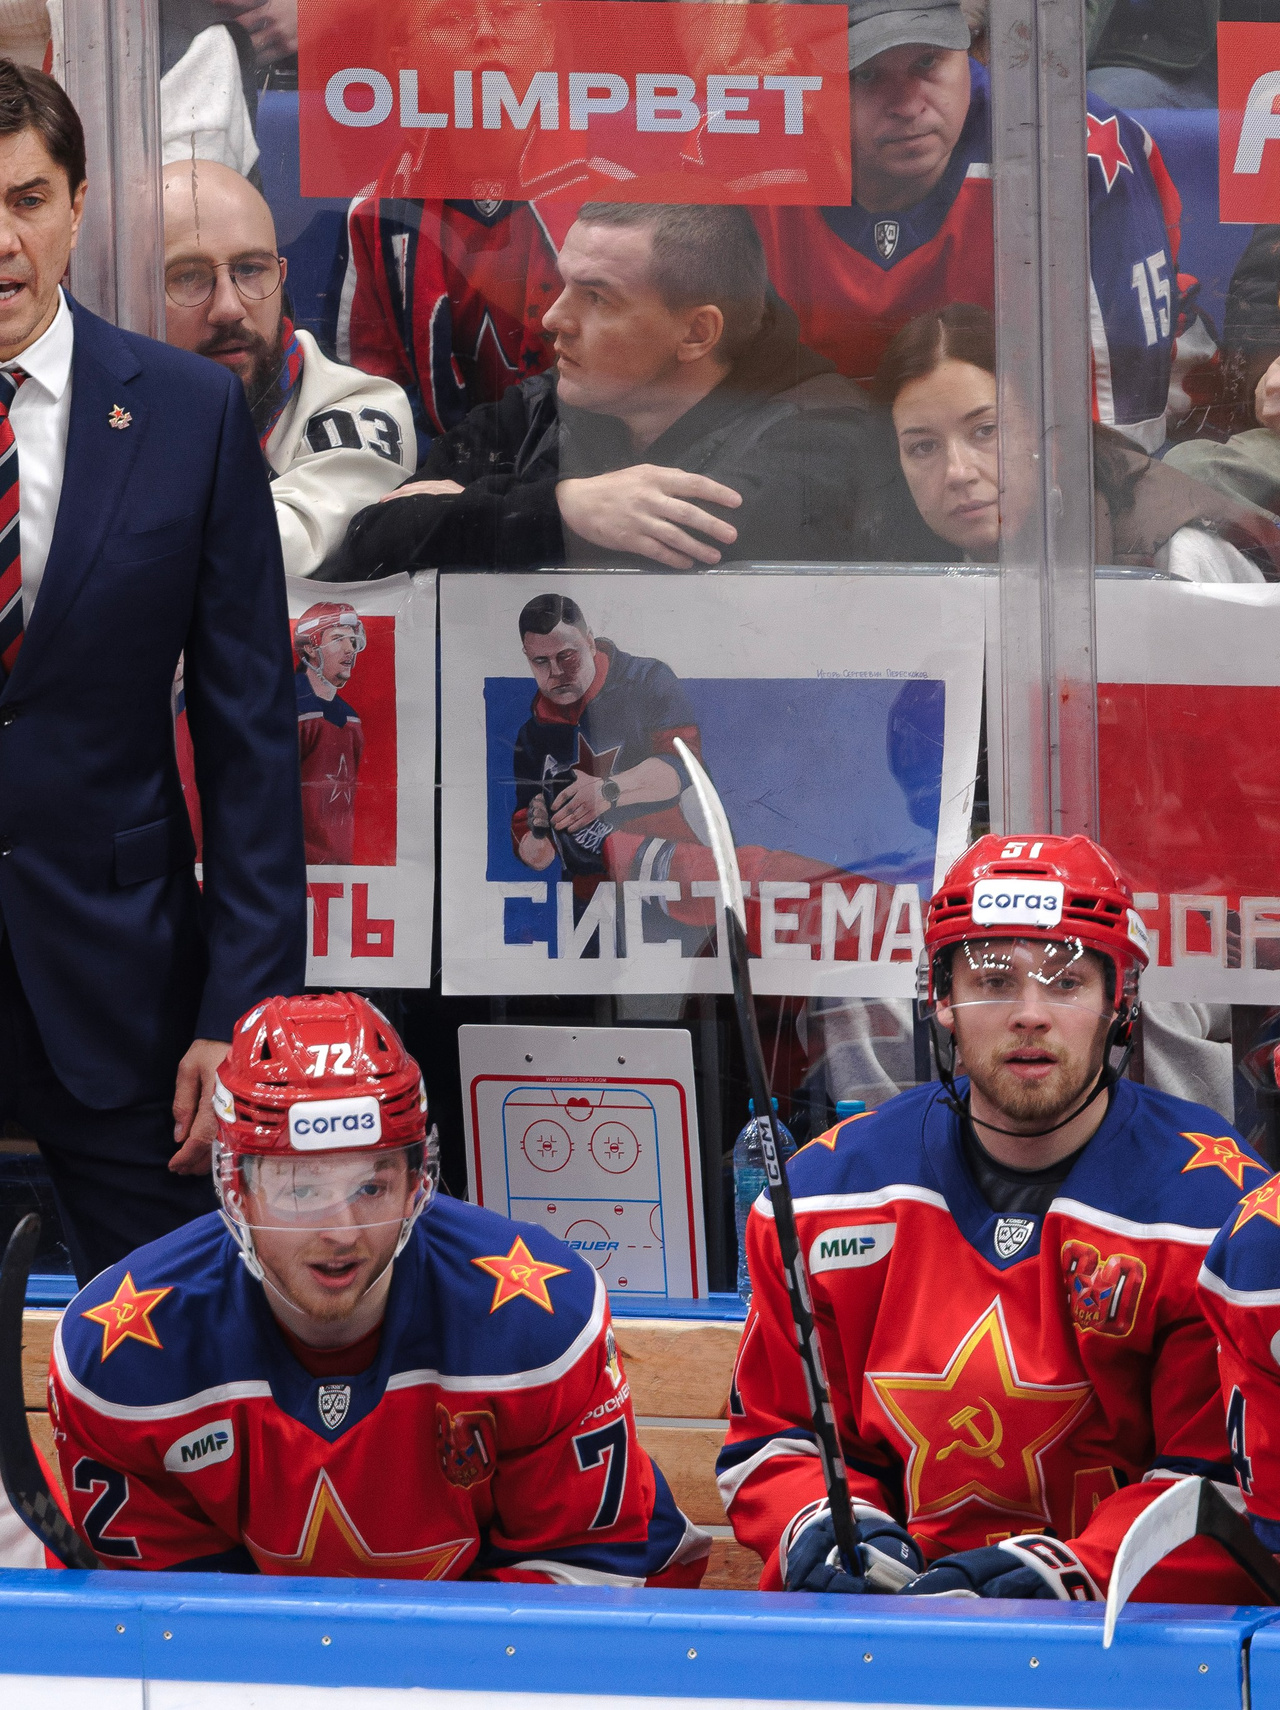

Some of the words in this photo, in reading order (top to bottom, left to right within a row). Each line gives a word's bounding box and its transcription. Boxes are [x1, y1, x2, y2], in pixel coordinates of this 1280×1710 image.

[324, 67, 823, 136] OLIMPBET
[1130, 250, 1172, 347] 15
[1000, 841, 1044, 859] 51
[486, 880, 926, 961] СИСТЕМА
[305, 1042, 355, 1078] 72
[758, 1119, 779, 1181] CCM
[820, 1236, 876, 1259] МИР
[180, 1431, 229, 1463] МИР
[572, 1413, 628, 1531] 7
[72, 1455, 143, 1560] 2
